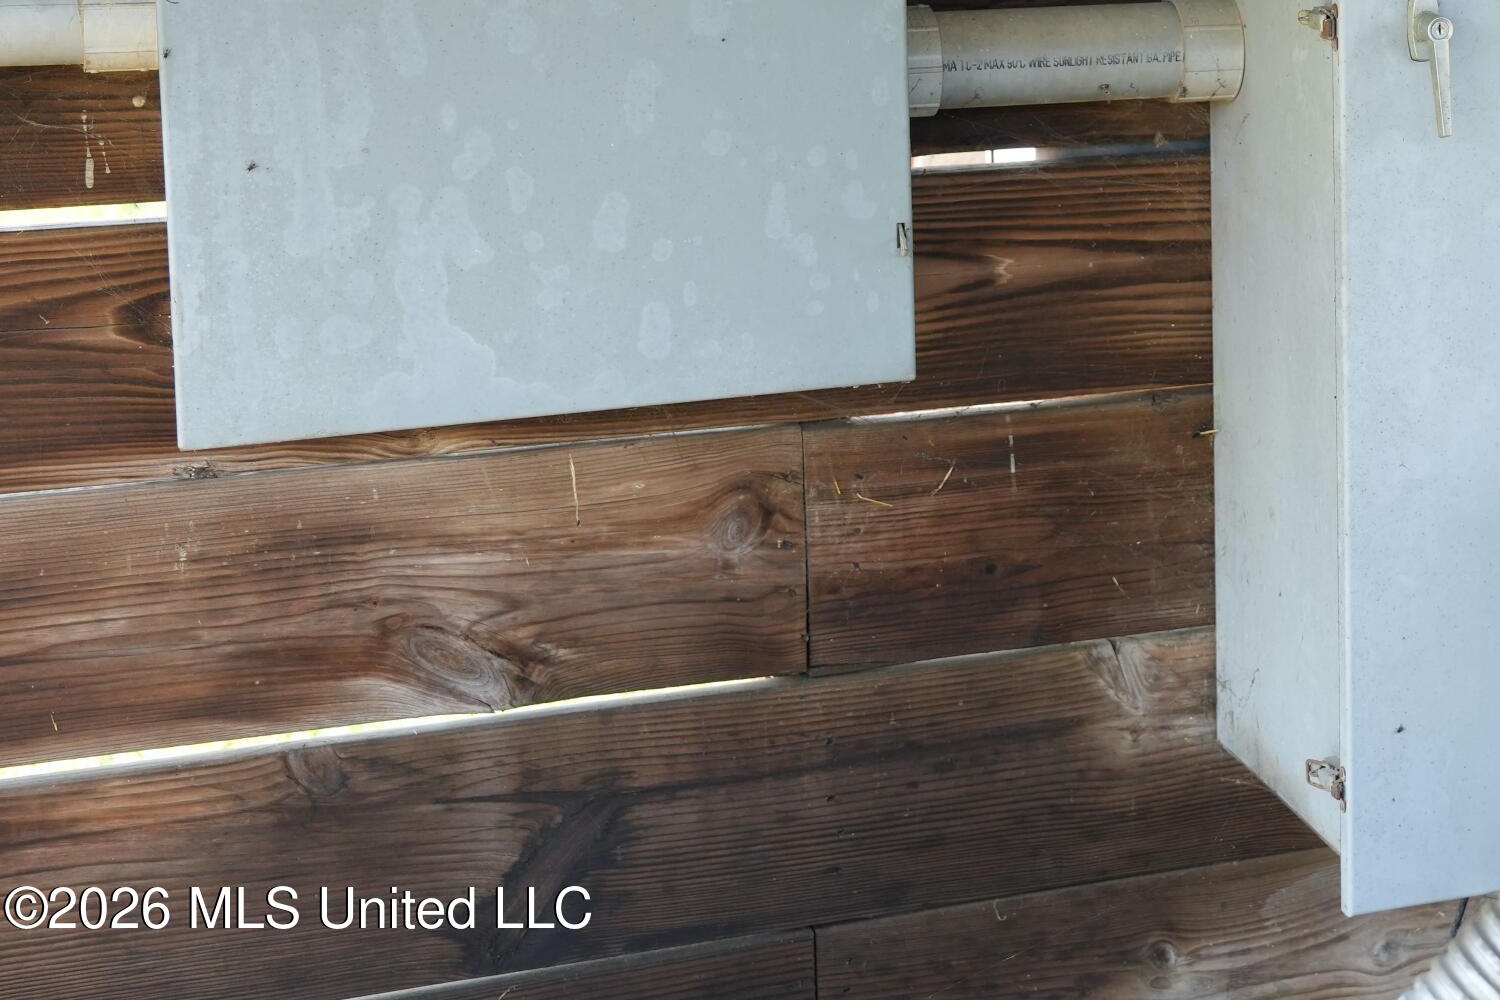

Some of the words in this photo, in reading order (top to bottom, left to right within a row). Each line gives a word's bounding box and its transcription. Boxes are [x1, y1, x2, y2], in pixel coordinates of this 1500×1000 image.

[983, 58, 1005, 70] MAX
[1029, 56, 1051, 68] WIRE
[1095, 51, 1143, 66] RESISTANT
